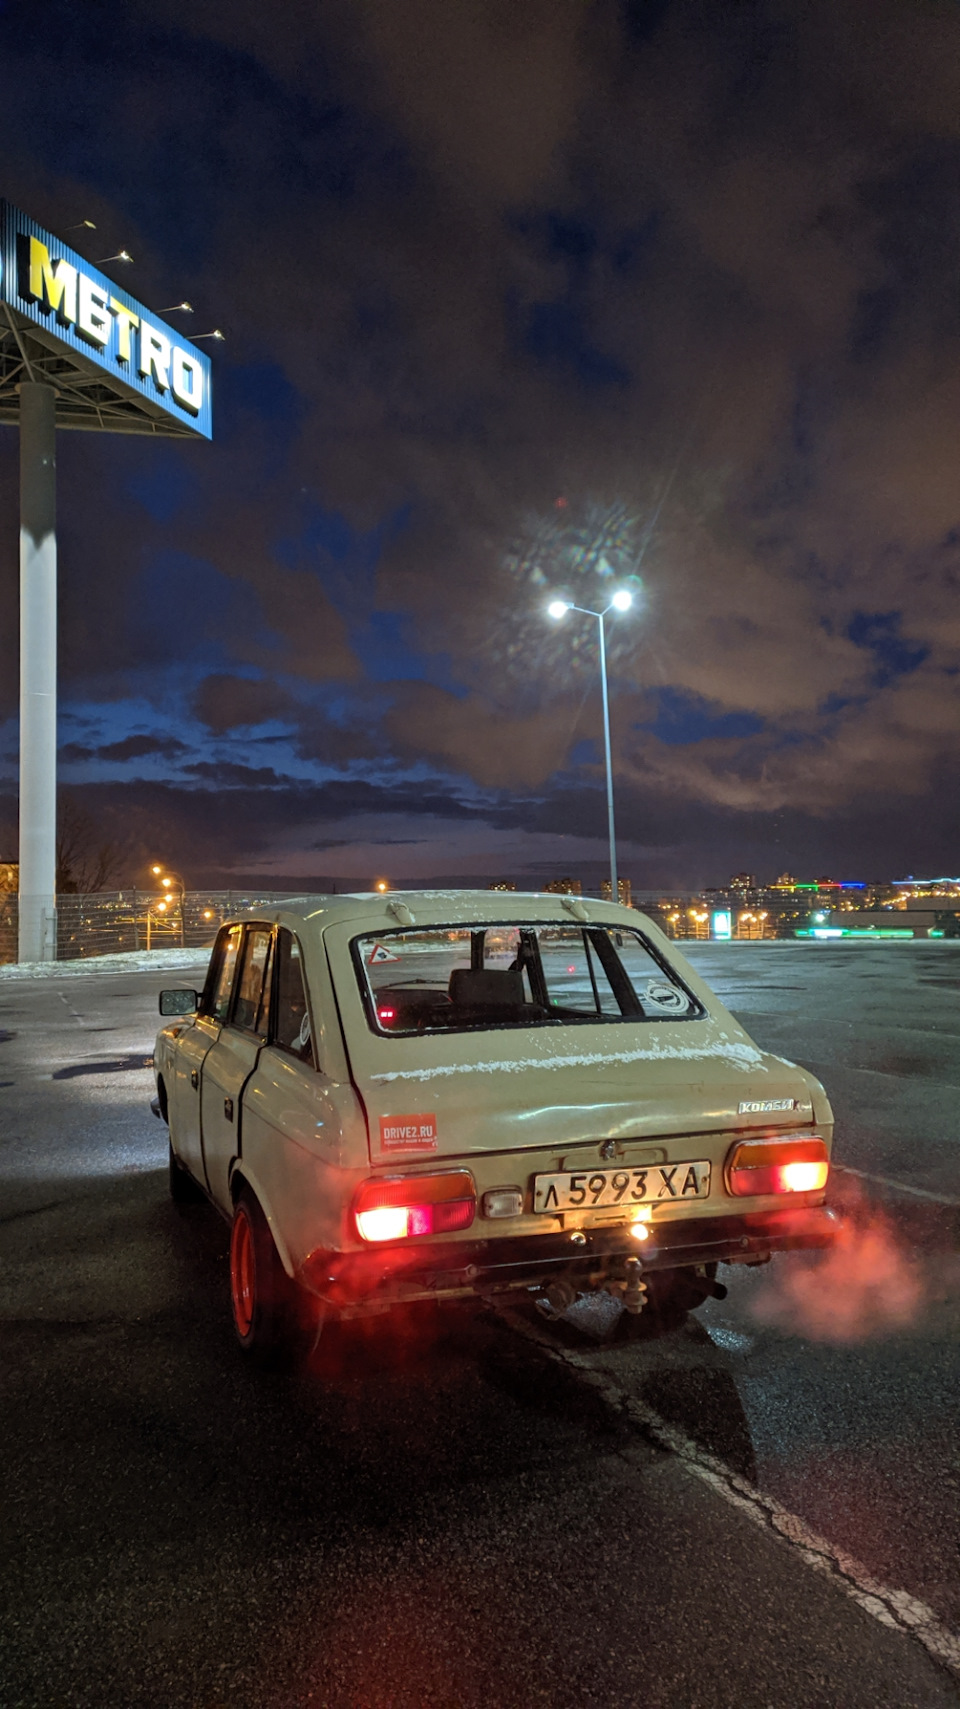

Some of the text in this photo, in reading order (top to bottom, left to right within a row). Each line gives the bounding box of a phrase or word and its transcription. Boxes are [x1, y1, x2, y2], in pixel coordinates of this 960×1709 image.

[29, 235, 203, 410] METRO
[383, 1125, 433, 1139] DRIVE2.RU
[569, 1171, 648, 1205] 5993
